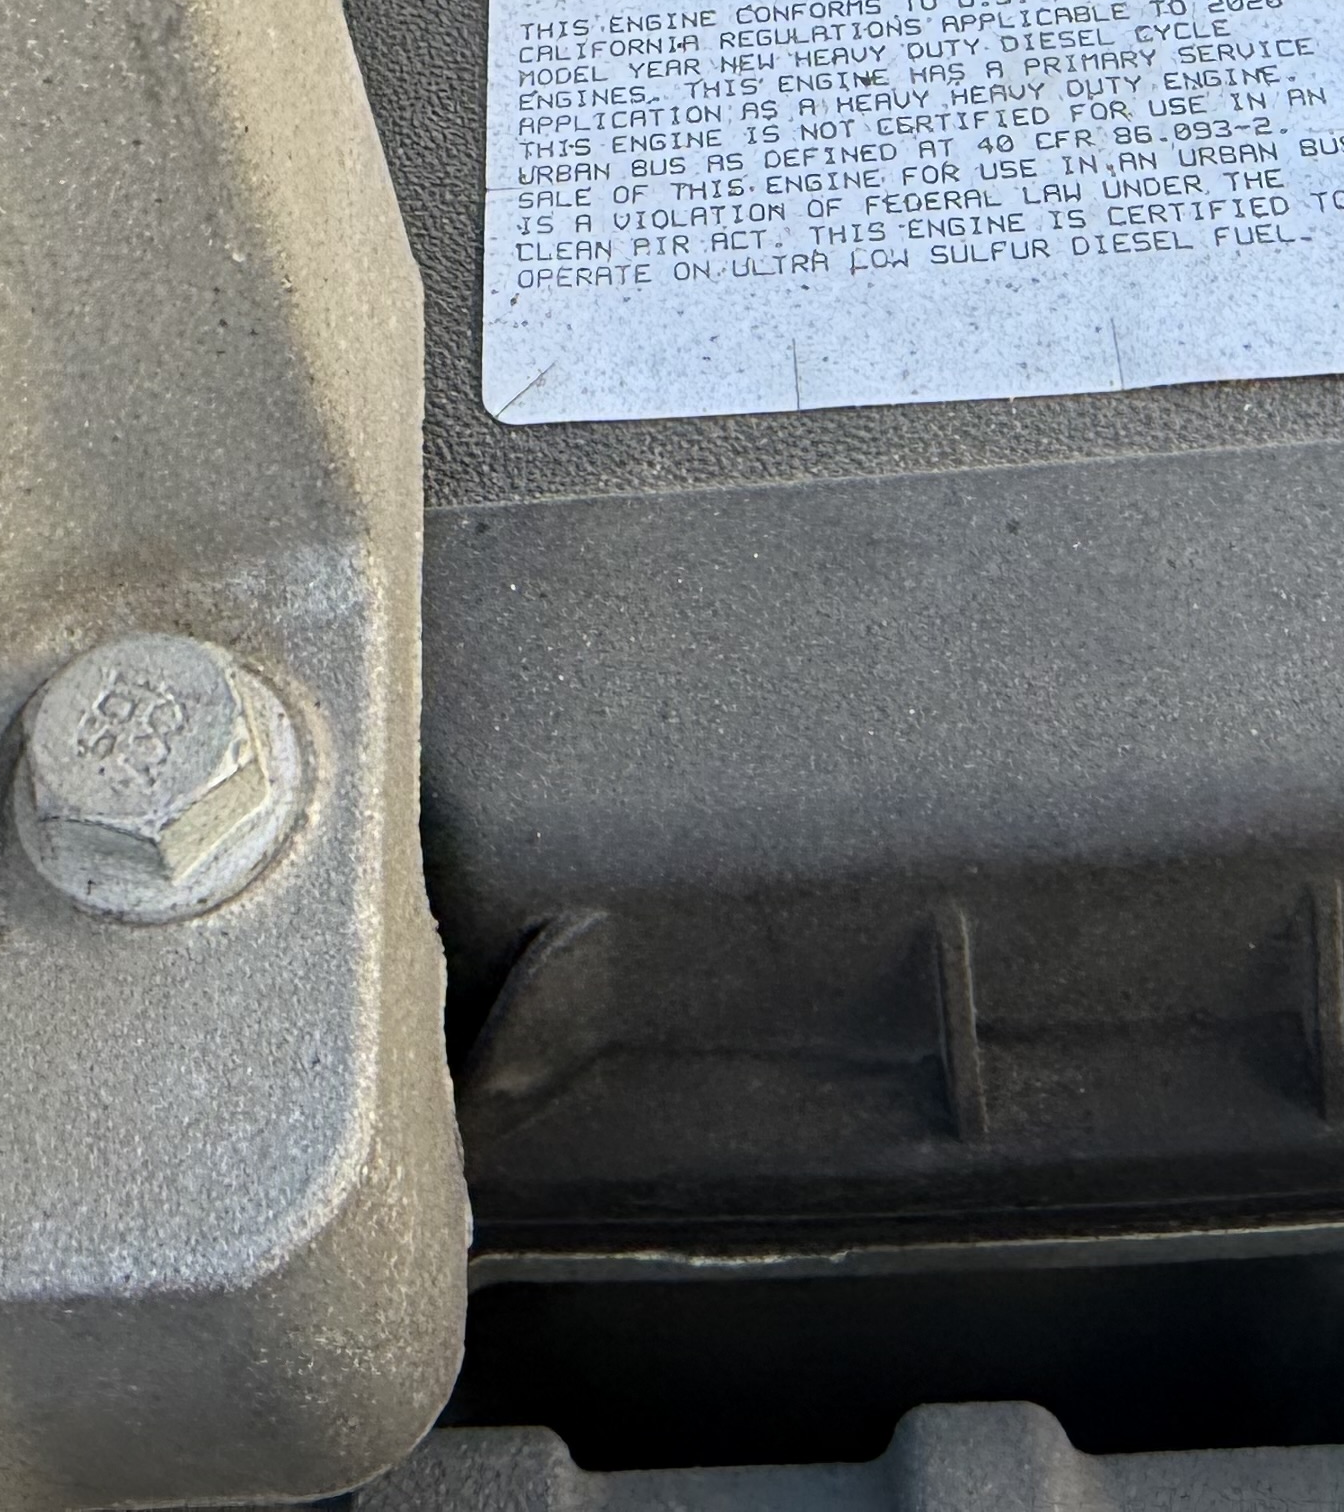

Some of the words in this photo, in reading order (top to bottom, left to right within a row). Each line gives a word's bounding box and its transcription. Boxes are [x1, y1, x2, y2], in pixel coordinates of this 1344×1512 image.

[519, 64, 608, 88] MODEL
[629, 57, 700, 80] YEAR
[720, 52, 775, 73] NEW
[794, 44, 887, 68] HEAVY
[906, 37, 981, 60] DUTY
[1001, 28, 1115, 53] DIESEL
[1134, 19, 1231, 44] CYCLE
[520, 19, 589, 41] THIS
[609, 9, 716, 34] ENGINE
[520, 34, 699, 64] CALIFORNIA
[719, 17, 922, 49] REGULATIONS
[941, 2, 1130, 33] APPLICABLE
[685, 77, 758, 99] THIS
[778, 68, 889, 93] ENGINE
[909, 62, 965, 83] HAS
[985, 60, 1004, 78] A
[1023, 49, 1158, 75] PRIMARY
[1177, 38, 1314, 64] SERVICE
[519, 104, 722, 135] APPLICATION
[742, 100, 778, 120] AS
[798, 97, 816, 116] A
[836, 89, 930, 113] HEAVY
[950, 81, 1046, 106] HEAVY
[1065, 74, 1143, 98] DUTY
[519, 137, 591, 160] THIS
[612, 128, 723, 154] ENGINE
[746, 124, 780, 145] IS
[800, 119, 856, 141] NOT
[877, 106, 1050, 136] CERTIFIED
[1069, 100, 1128, 123] FOR
[1148, 95, 1207, 117] USE
[1229, 91, 1267, 112] IN
[1286, 87, 1327, 108] AN
[519, 161, 610, 185] URBAN
[631, 156, 686, 178] BUS
[707, 152, 744, 173] AS
[764, 142, 898, 169] DEFINED
[918, 138, 956, 159] AT
[976, 134, 1015, 155] 40
[1034, 129, 1093, 151] CFR
[519, 187, 592, 211] SALE
[613, 183, 649, 205] OF
[670, 177, 745, 201] THIS
[766, 168, 881, 195] ENGINE
[901, 163, 959, 186] FOR
[979, 158, 1038, 181] USE
[1061, 154, 1098, 175] IN
[1117, 150, 1158, 172] AN
[1177, 142, 1279, 168] URBAN
[518, 238, 612, 264] CLEAN
[634, 233, 690, 256] AIR
[809, 221, 886, 245] THIS
[907, 212, 1026, 239] ENGINE
[1049, 208, 1087, 230] IS
[1107, 195, 1291, 226] CERTIFIED
[521, 216, 554, 237] IS
[576, 213, 592, 234] A
[614, 201, 786, 231] VIOLATION
[807, 197, 844, 219] OF
[865, 187, 1002, 215] FEDERAL
[1023, 182, 1082, 205] LAW
[1102, 174, 1203, 200] UNDER
[1223, 168, 1285, 192] THE
[518, 263, 652, 291] OPERATE
[673, 259, 711, 281] ON
[732, 252, 829, 277] ULTRA
[850, 247, 909, 270] LOW
[930, 238, 1050, 265] SULFUR
[1071, 229, 1194, 256] DIESEL
